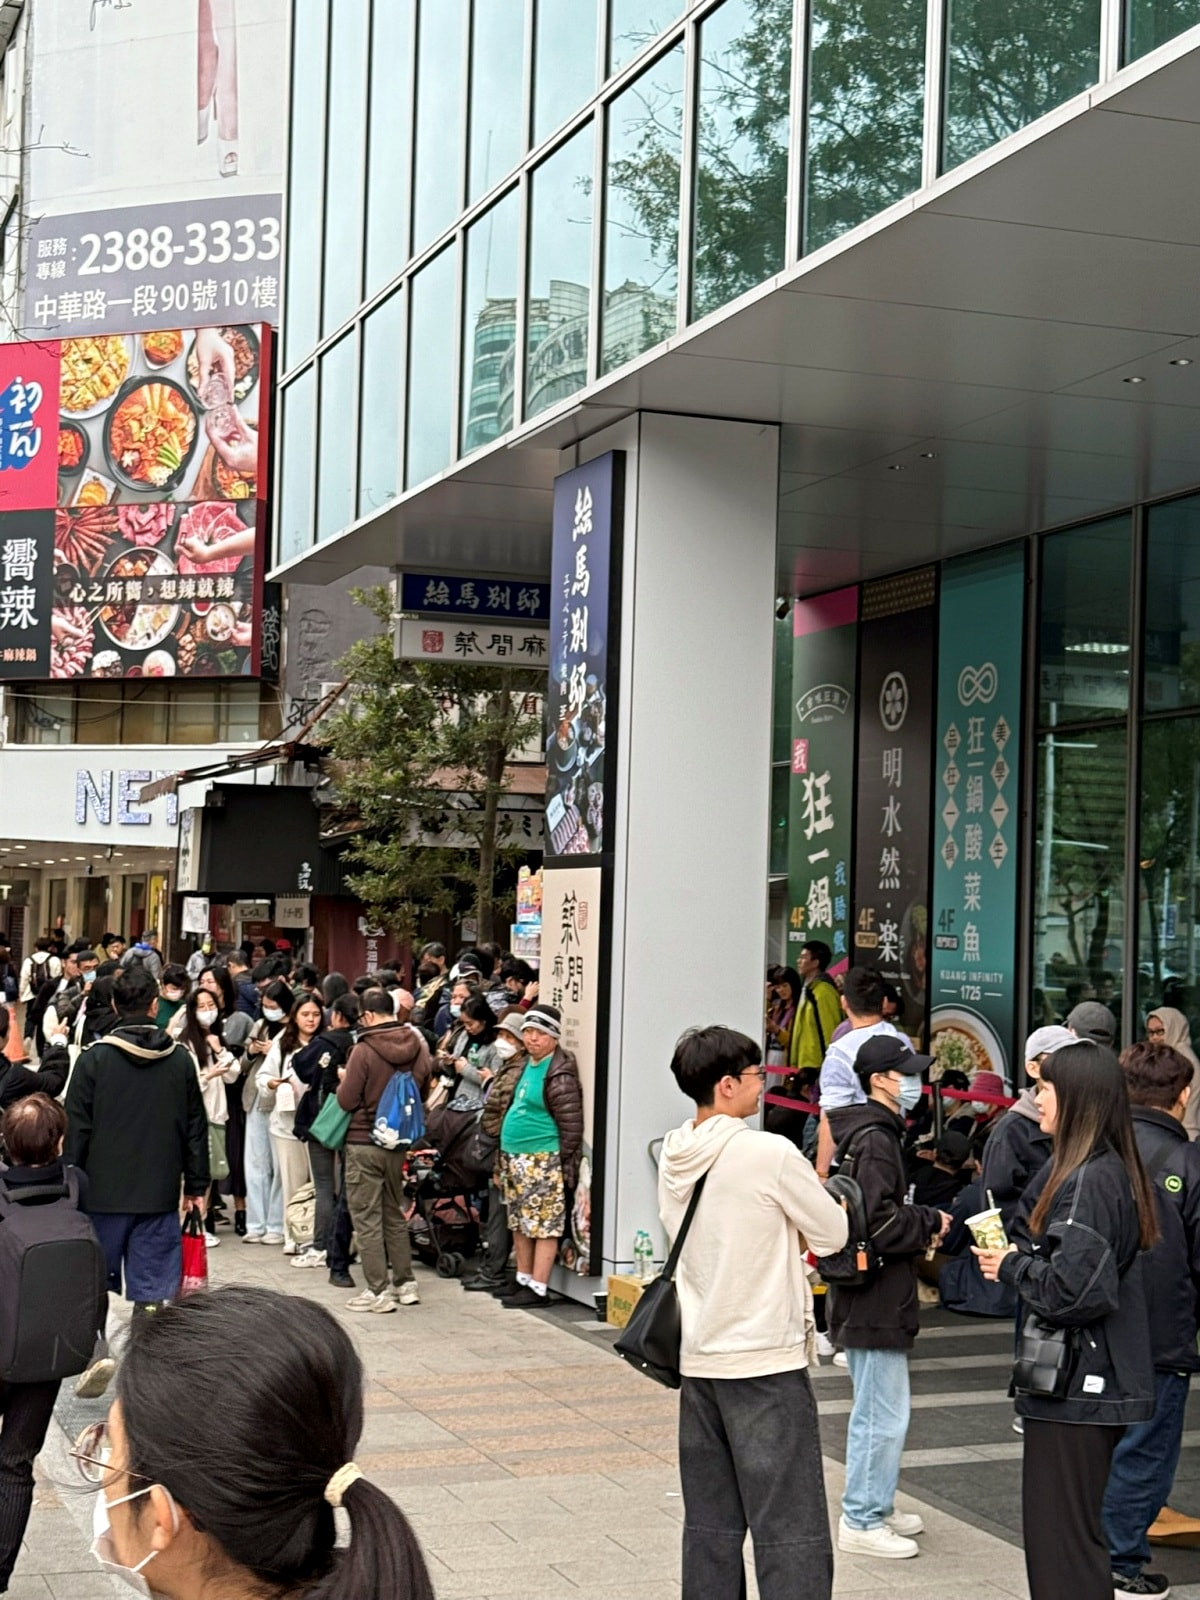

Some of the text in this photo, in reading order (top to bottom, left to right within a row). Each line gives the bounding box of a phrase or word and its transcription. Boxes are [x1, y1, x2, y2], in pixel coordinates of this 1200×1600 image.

[37, 237, 68, 259] 服務
[36, 260, 67, 280] 專線
[34, 275, 279, 326] 中華路一段90號10樓
[801, 770, 834, 930] 狂一鍋
[962, 716, 985, 962] 狂一鍋酸菜魚
[790, 907, 805, 928] 4F
[858, 908, 874, 930] 4F
[938, 909, 955, 932] 4F
[940, 969, 1003, 983] KUANG INFINITY
[960, 984, 981, 1001] 1725
